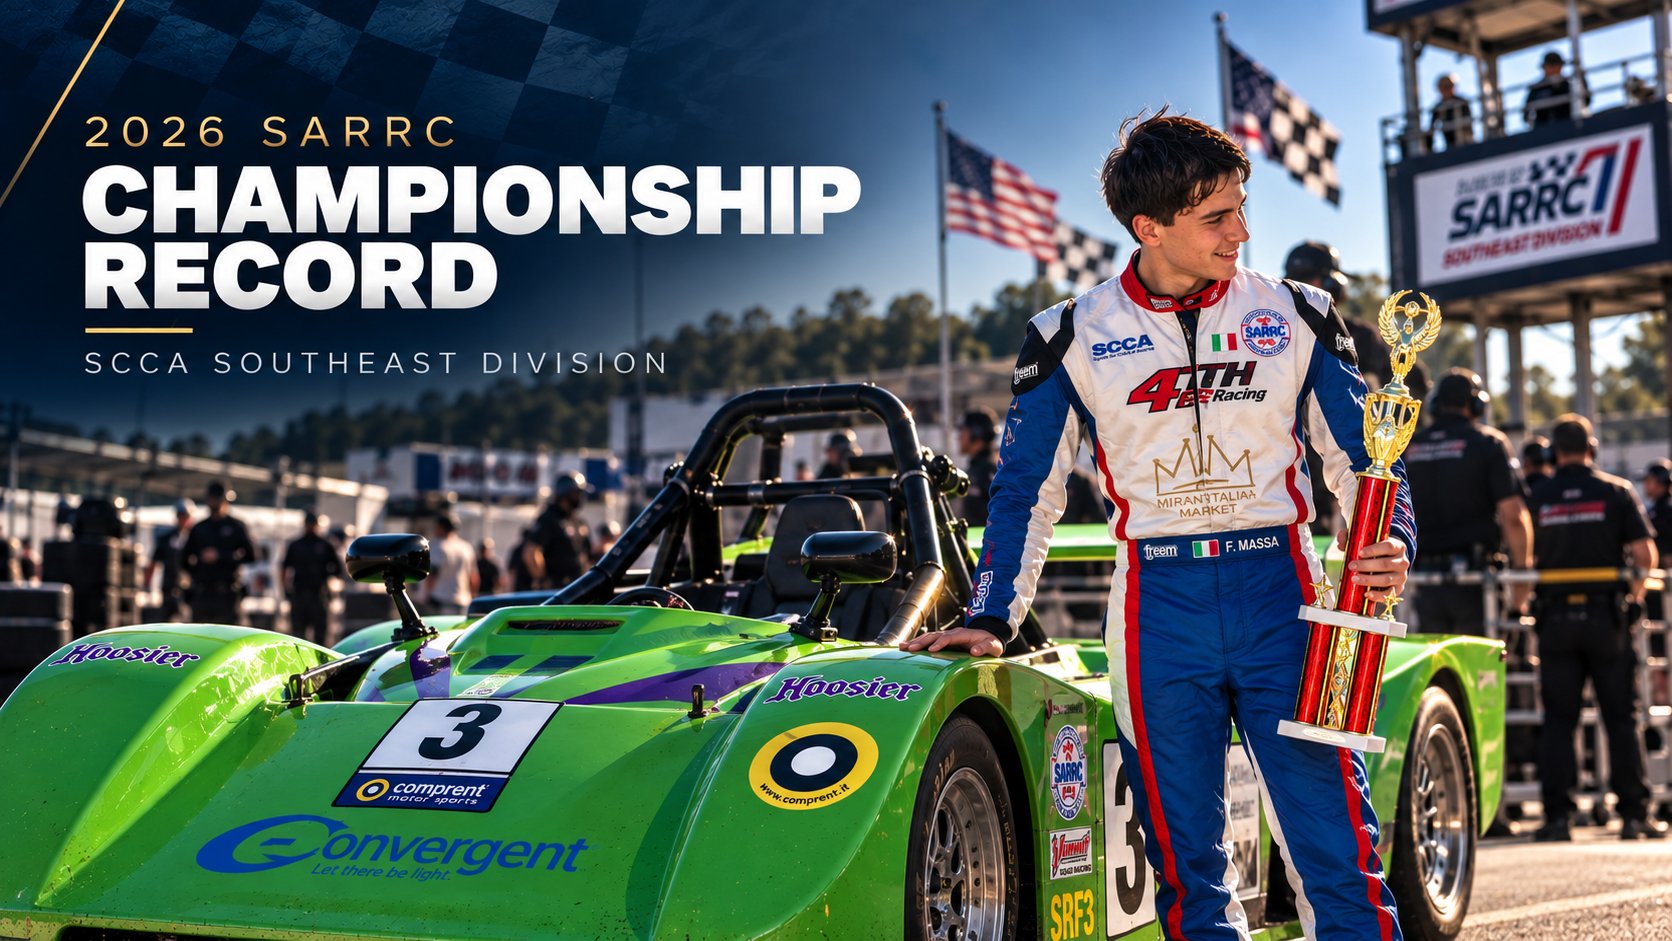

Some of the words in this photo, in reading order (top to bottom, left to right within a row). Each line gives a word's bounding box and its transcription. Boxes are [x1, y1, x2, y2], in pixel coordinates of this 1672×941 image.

[1447, 175, 1588, 241] SARRC
[1443, 232, 1530, 268] SOUTHEAST
[1532, 218, 1603, 250] DIVISION
[1245, 326, 1286, 338] SARRC
[1092, 334, 1154, 356] SCCA
[1014, 364, 1038, 385] freem
[1212, 388, 1267, 402] Racing
[1179, 504, 1237, 517] MARKET
[1144, 544, 1178, 560] freem
[1226, 540, 1236, 553] F.
[1239, 536, 1279, 551] MASSA
[48, 642, 200, 668] Hoosier
[763, 675, 922, 702] Hoosier
[418, 703, 502, 760] 3
[1054, 761, 1083, 783] SARRC
[387, 795, 430, 803] motor
[434, 797, 478, 805] sports
[393, 783, 486, 797] comprent
[760, 783, 850, 806] www.comprent.it
[196, 814, 588, 876] Convergent
[311, 863, 340, 876] Let
[342, 865, 387, 878] there
[388, 867, 408, 878] be
[410, 868, 452, 882] light.
[1051, 889, 1095, 941] SRF3
